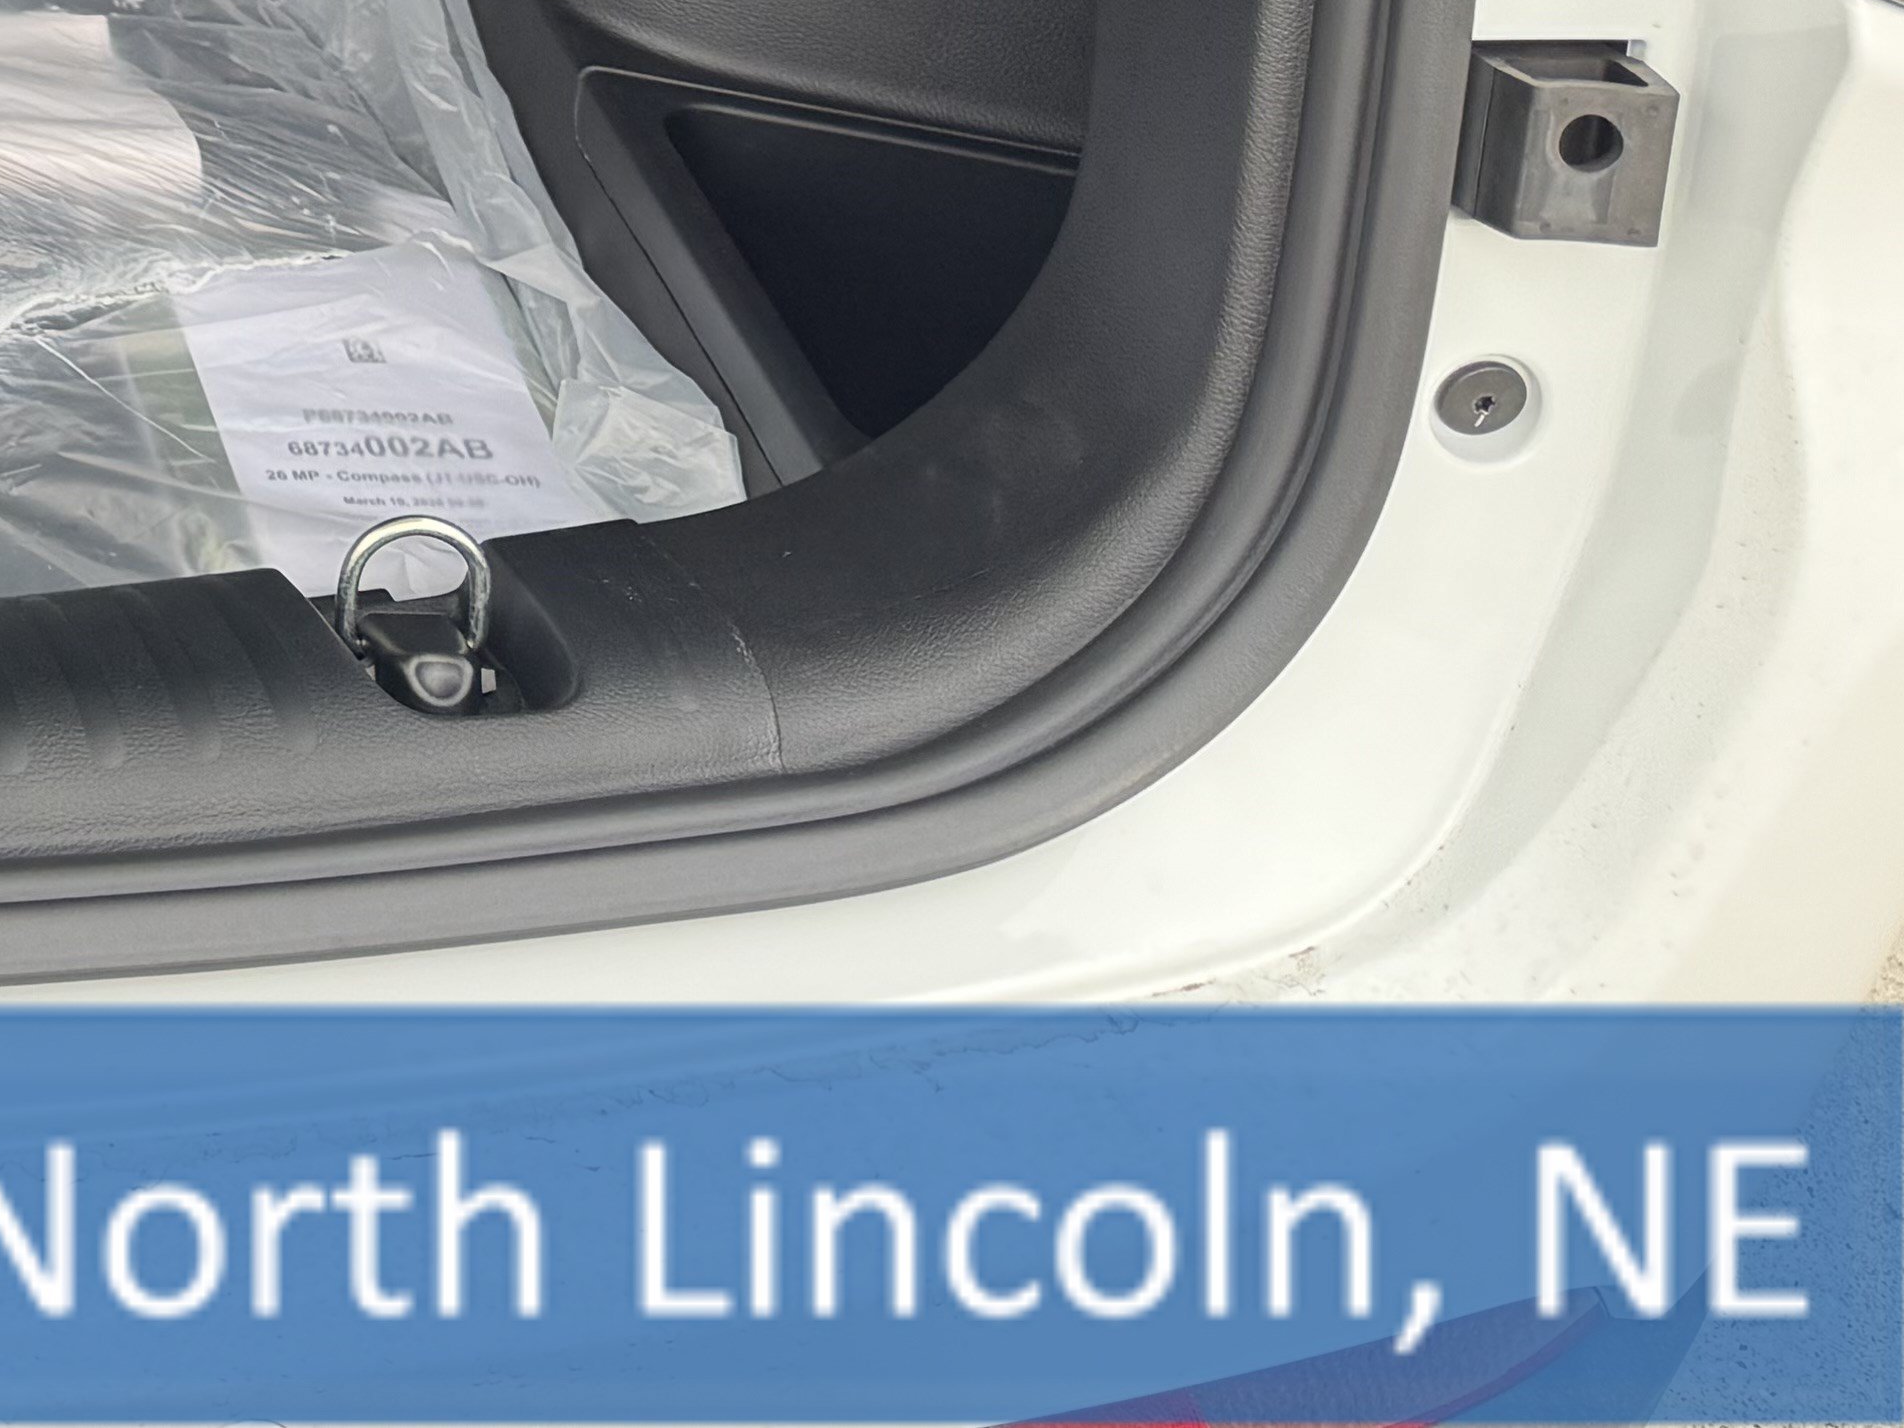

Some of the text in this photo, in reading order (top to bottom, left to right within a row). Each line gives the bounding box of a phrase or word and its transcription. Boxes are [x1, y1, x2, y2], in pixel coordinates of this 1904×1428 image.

[288, 435, 493, 460] 68734002AB
[292, 470, 320, 482] MP
[337, 470, 422, 485] Compass
[343, 496, 386, 507] March
